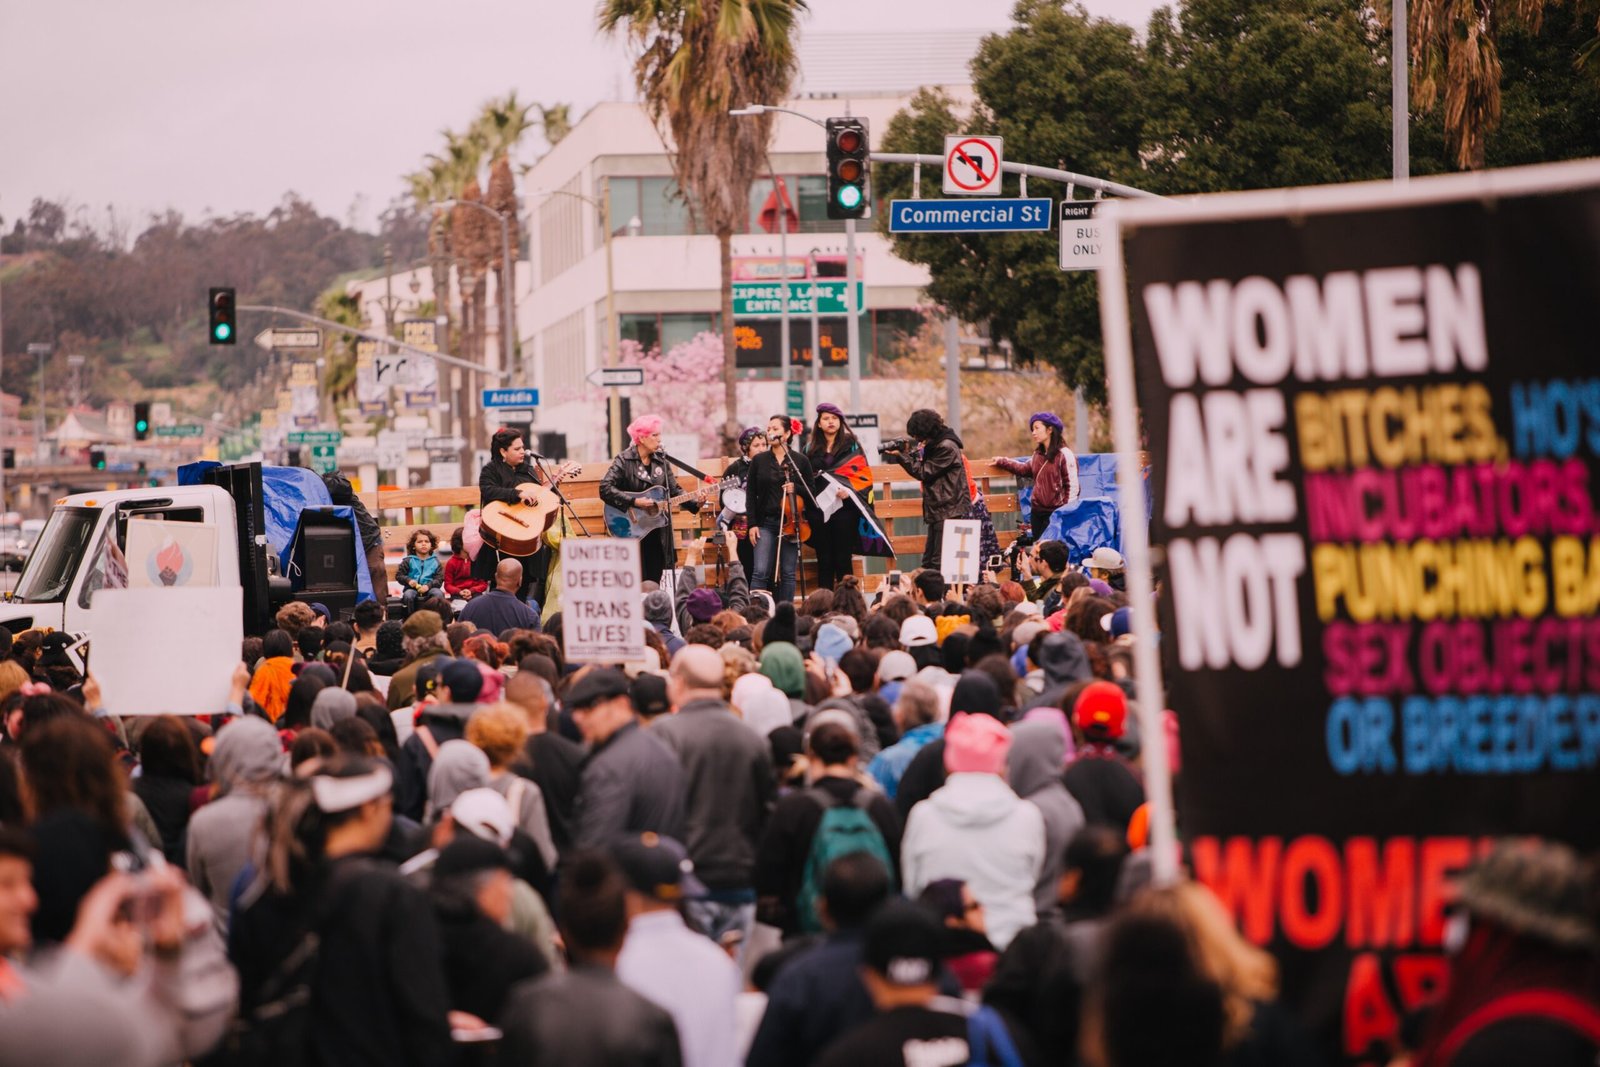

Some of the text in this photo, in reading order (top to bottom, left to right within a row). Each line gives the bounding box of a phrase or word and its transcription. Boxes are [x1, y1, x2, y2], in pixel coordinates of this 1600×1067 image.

[901, 205, 1042, 224] Commercial St
[1065, 207, 1088, 216] RIGHT
[1077, 228, 1100, 239] BUS
[1073, 244, 1103, 255] ONLY
[796, 286, 834, 299] LANE
[746, 300, 815, 312] ENTRNC
[1143, 262, 1488, 389] WOMEN
[1164, 387, 1296, 528] ARE
[1294, 382, 1509, 472] BITCHES,
[568, 545, 612, 560] UNITE
[567, 570, 634, 589] DEFEND
[572, 600, 631, 618] TRANS
[1167, 532, 1305, 670] NOT
[1312, 533, 1547, 624] PUNCHING
[577, 625, 632, 643] LIVES!
[1323, 619, 1413, 696] SEX
[1326, 696, 1397, 774] OR
[1192, 835, 1494, 949] WOME
[1343, 952, 1452, 1056] AR
